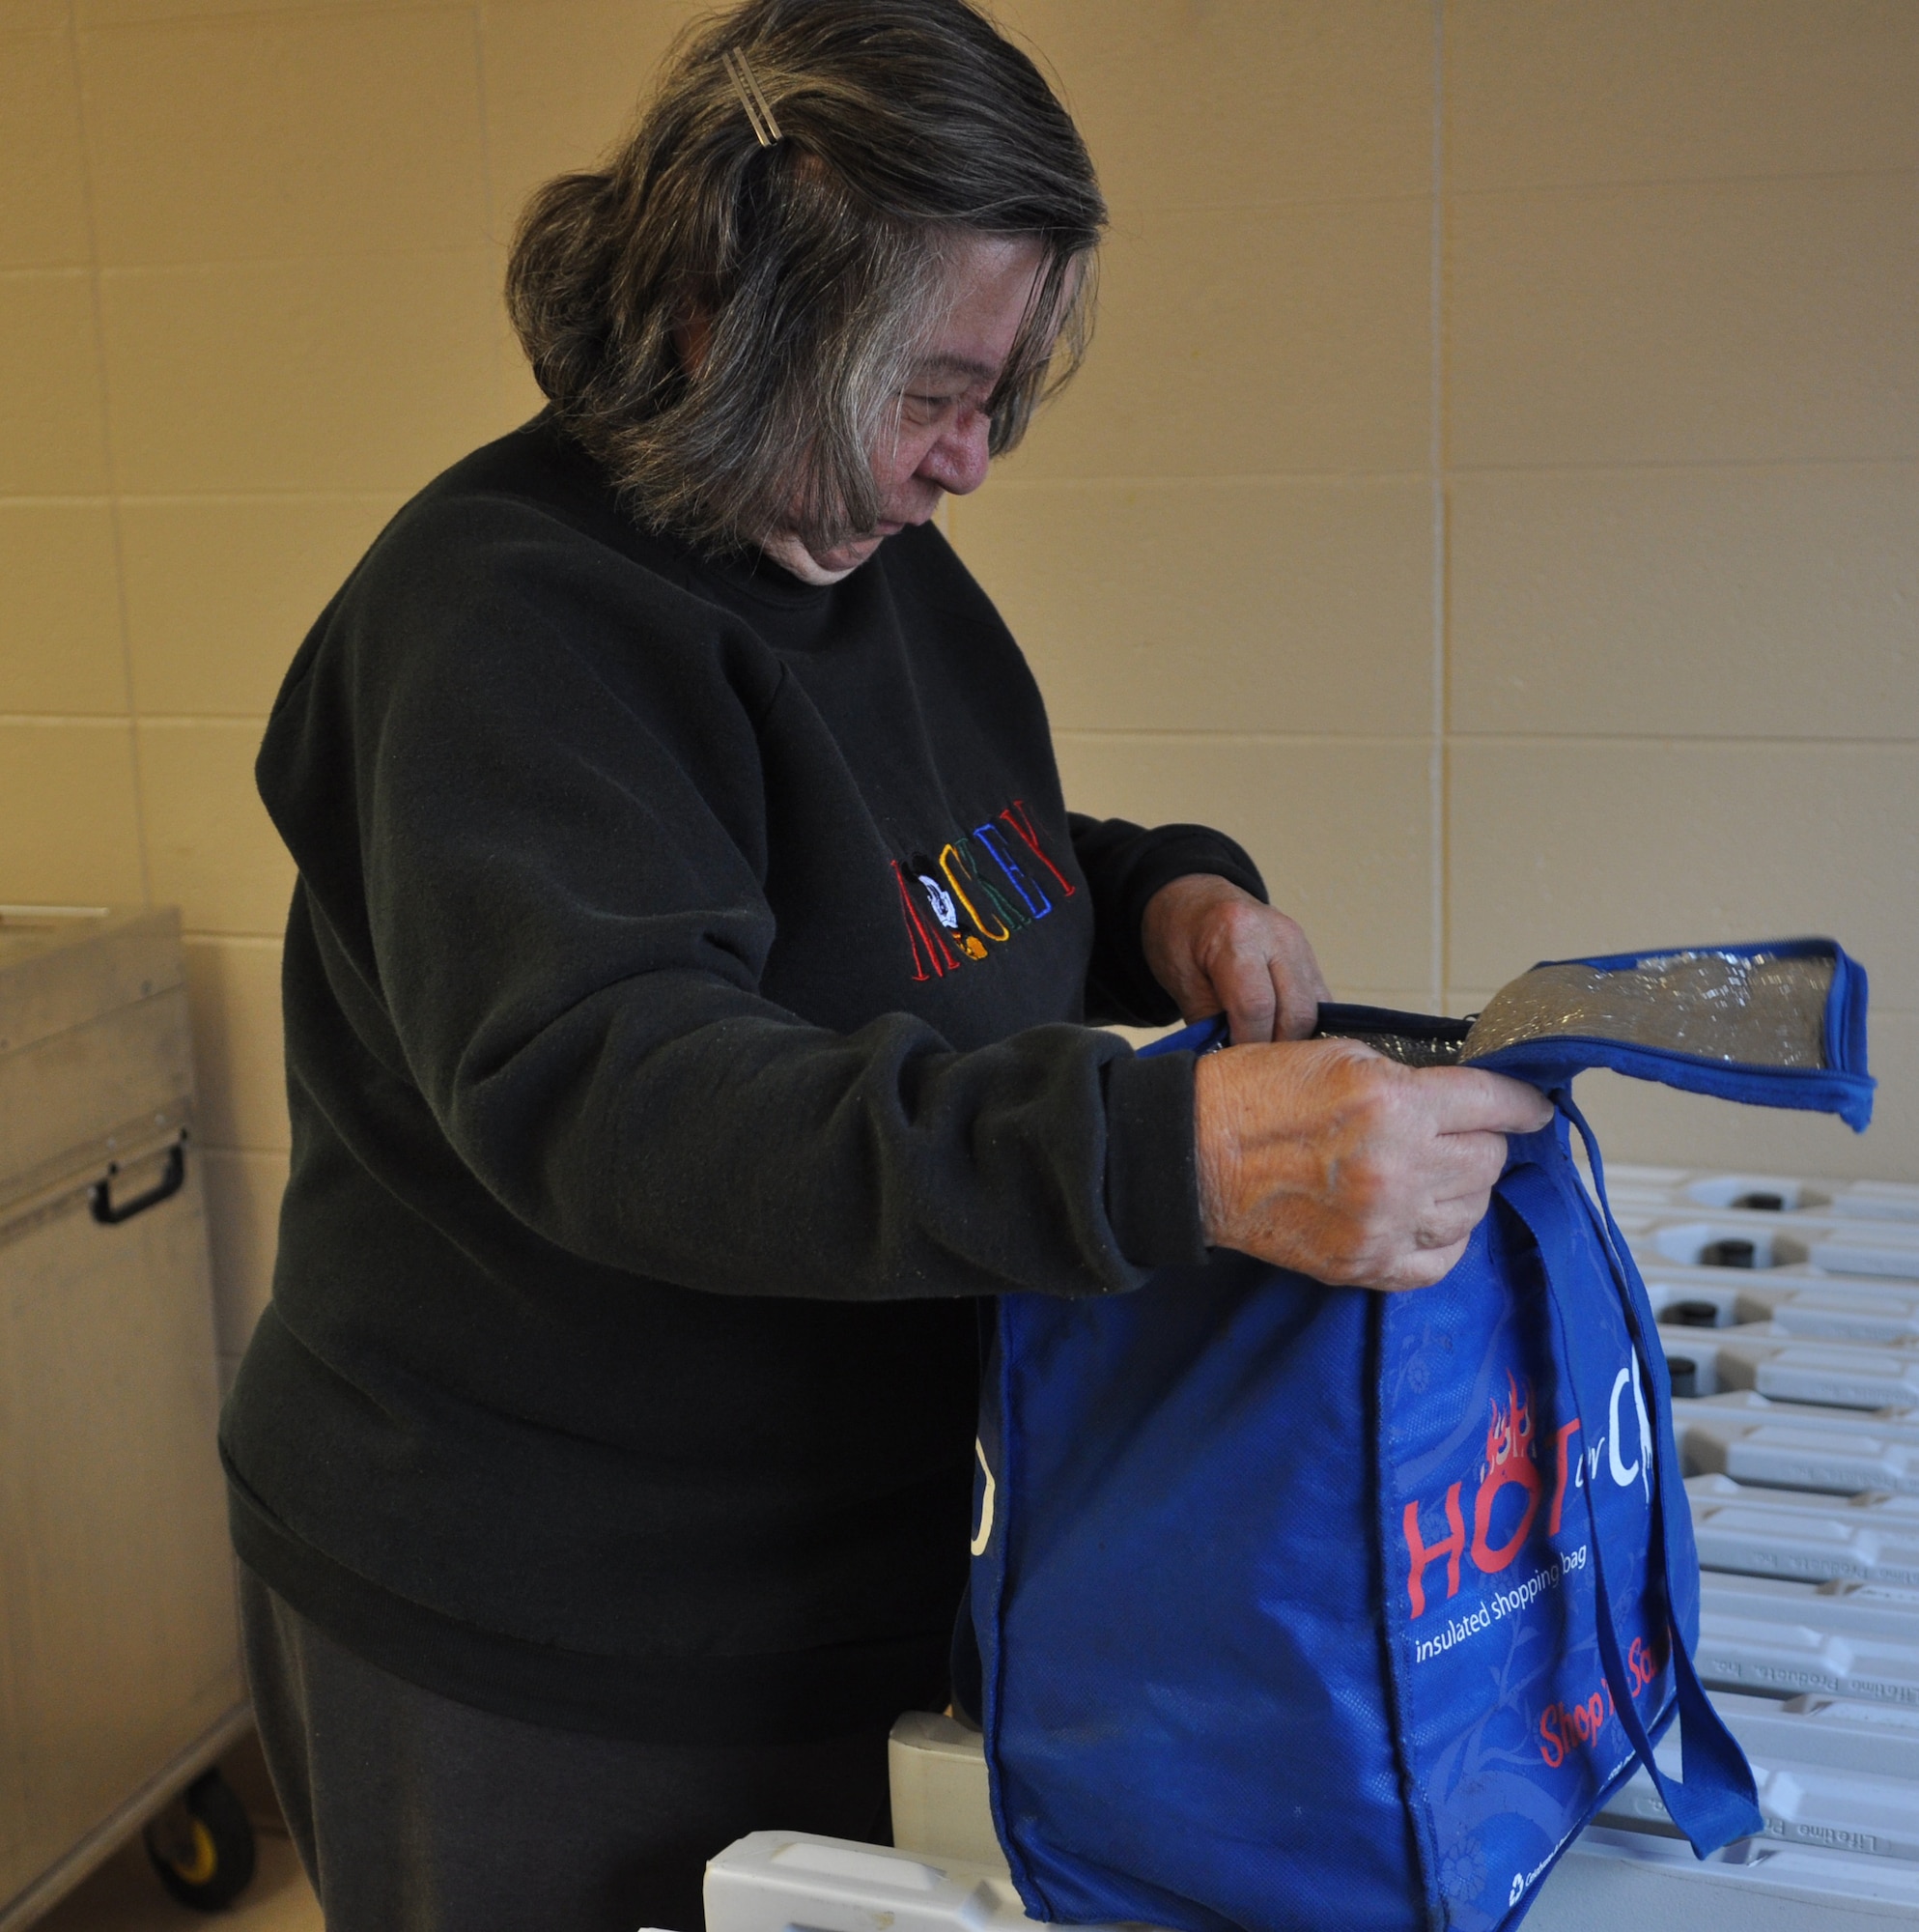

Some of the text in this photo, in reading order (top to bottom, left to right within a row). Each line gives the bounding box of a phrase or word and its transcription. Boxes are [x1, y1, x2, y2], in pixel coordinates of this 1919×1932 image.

[1402, 1368, 1581, 1620] HOT
[1415, 1544, 1588, 1663] insulated shopping bag
[1539, 1691, 1604, 1769] Shop
[1795, 1823, 1877, 1852] Lifetime
